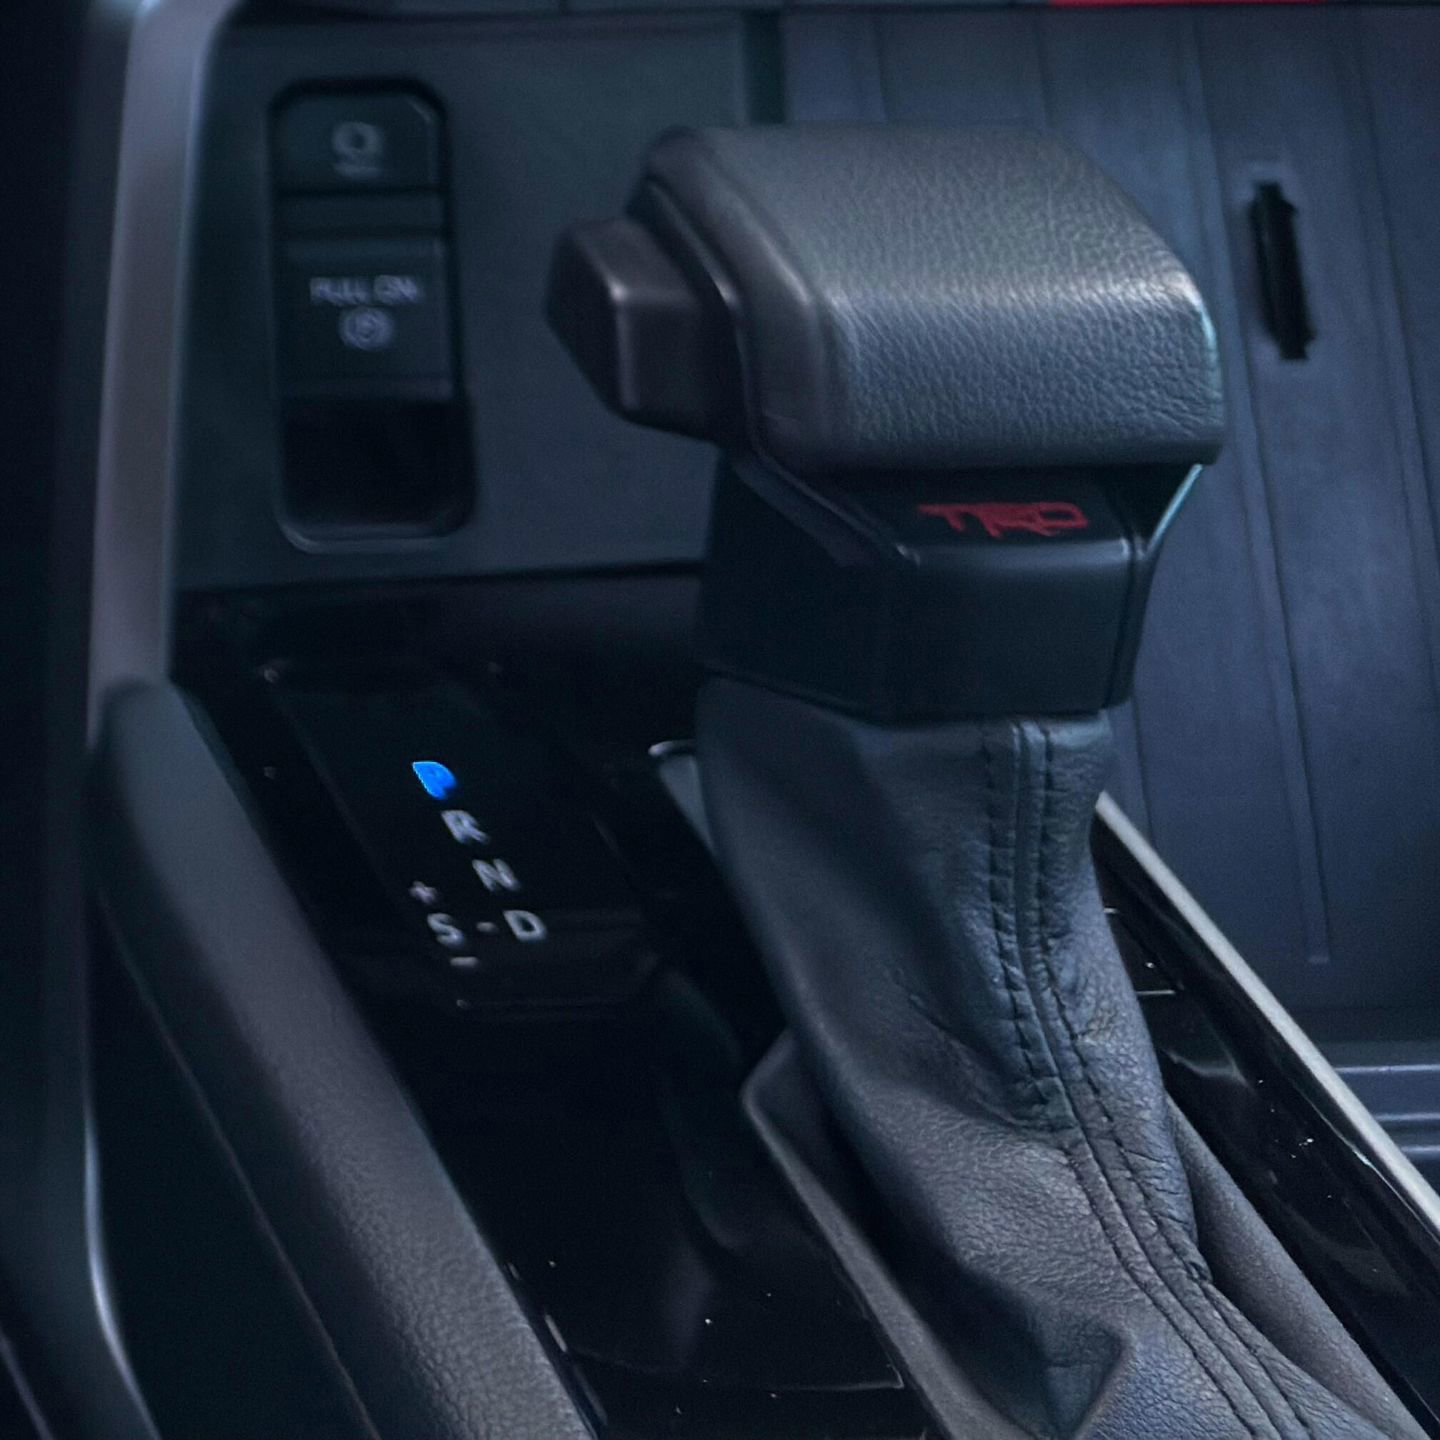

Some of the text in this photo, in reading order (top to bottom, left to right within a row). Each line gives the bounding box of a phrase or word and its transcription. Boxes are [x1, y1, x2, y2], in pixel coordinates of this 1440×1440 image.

[915, 500, 1090, 539] TRD
[411, 759, 458, 801] P
[441, 809, 491, 845] R
[471, 858, 522, 893] N
[427, 908, 549, 949] S D
